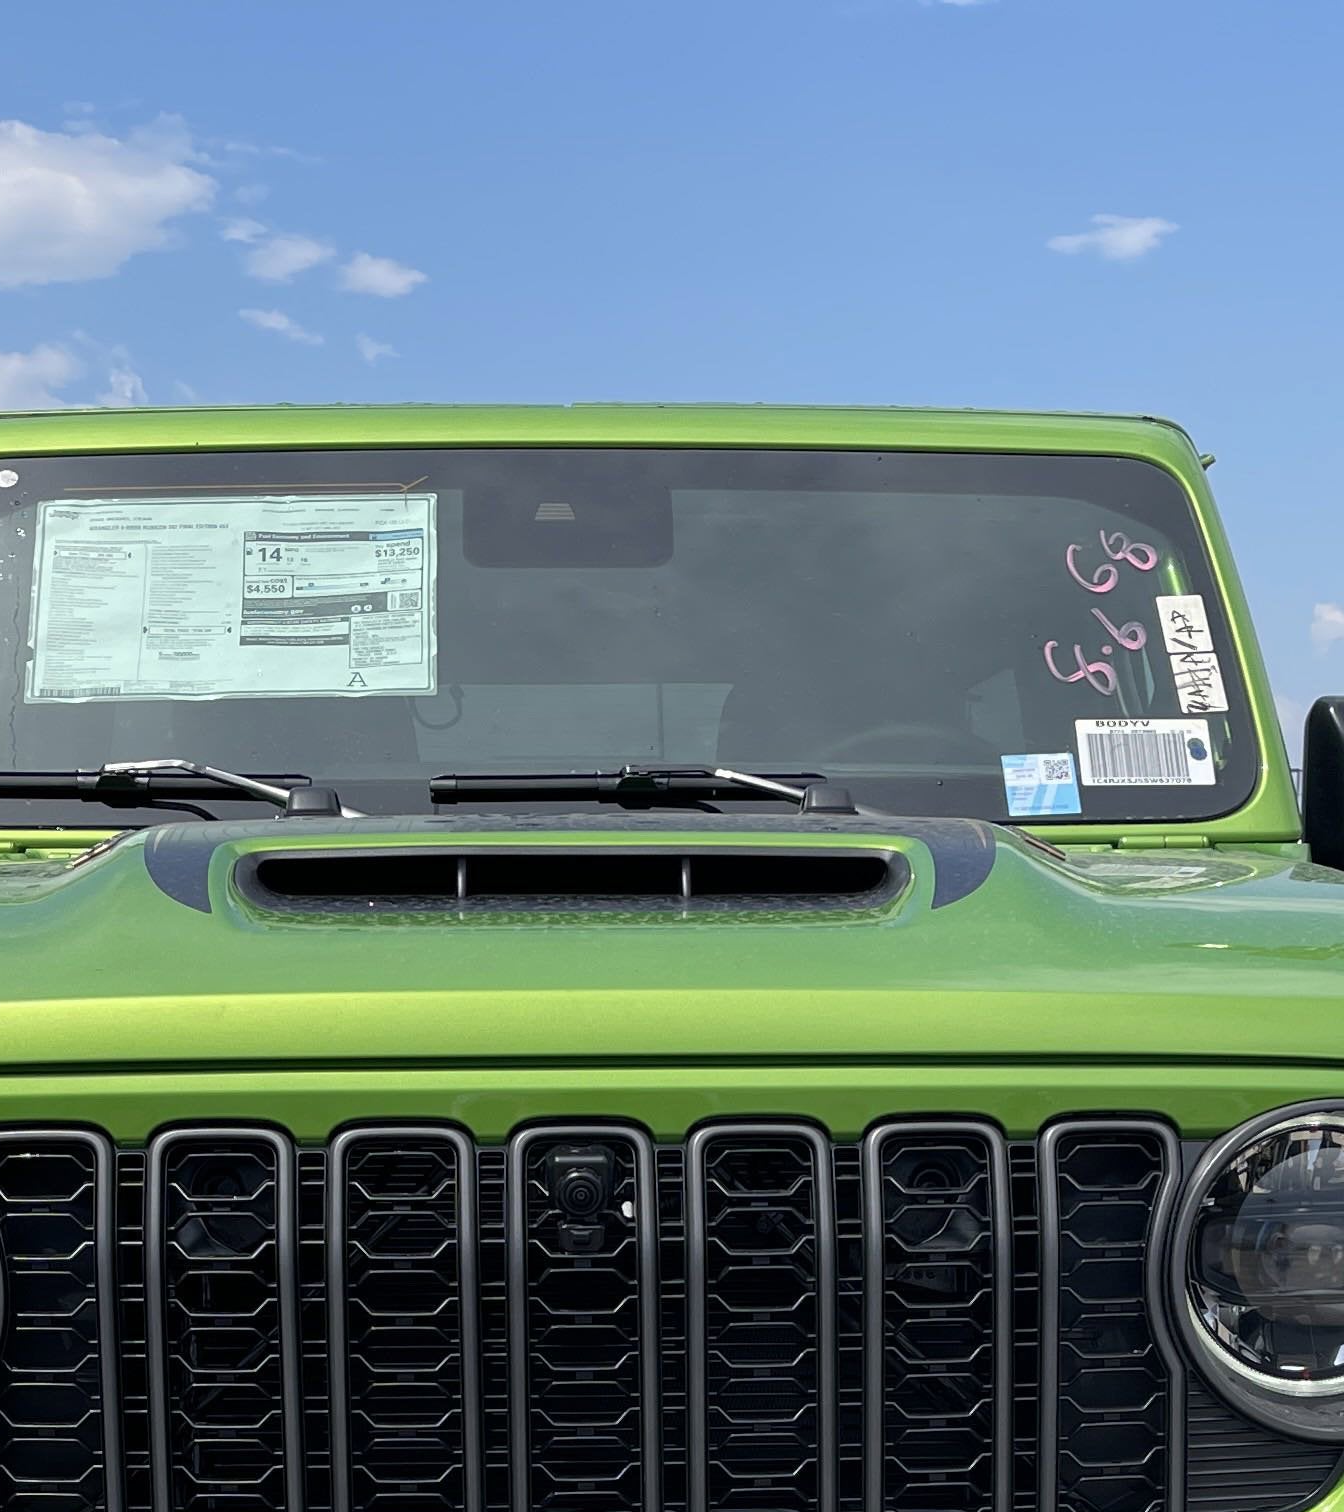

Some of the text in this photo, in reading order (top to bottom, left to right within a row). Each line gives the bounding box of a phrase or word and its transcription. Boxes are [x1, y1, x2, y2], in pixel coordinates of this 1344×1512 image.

[258, 547, 283, 562] 14
[375, 547, 420, 558] $13,250
[246, 584, 286, 594] $4,550
[346, 671, 368, 687] A
